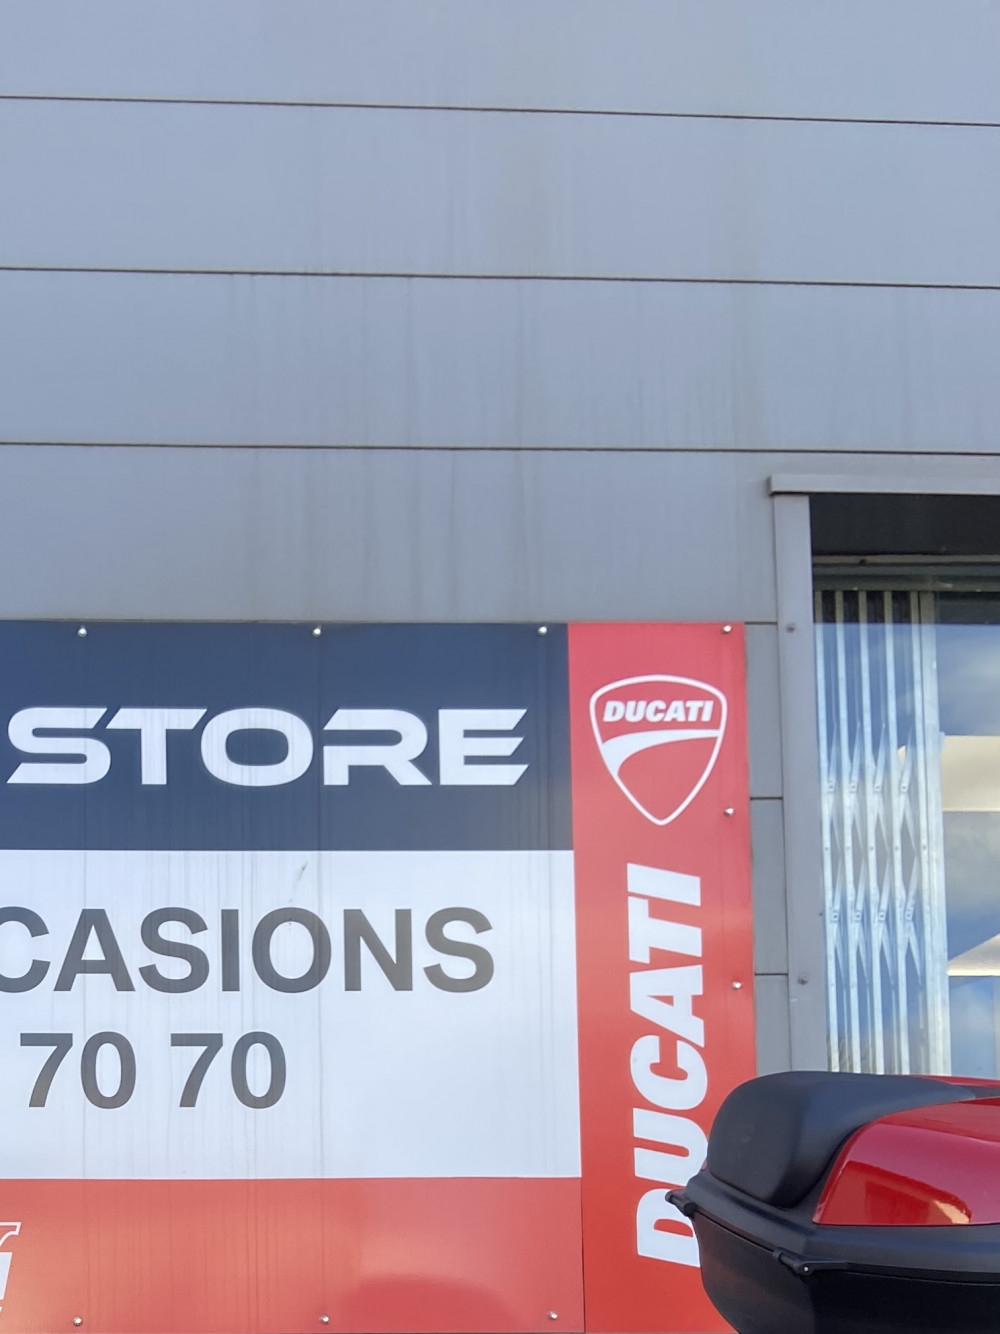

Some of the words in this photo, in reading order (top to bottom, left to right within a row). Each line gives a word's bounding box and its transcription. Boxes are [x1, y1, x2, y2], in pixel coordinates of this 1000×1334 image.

[7, 707, 528, 788] STORE
[602, 700, 714, 723] DUCATI
[19, 1031, 137, 1109] 70
[170, 1031, 287, 1109] 70
[627, 863, 709, 1268] DUCATI
